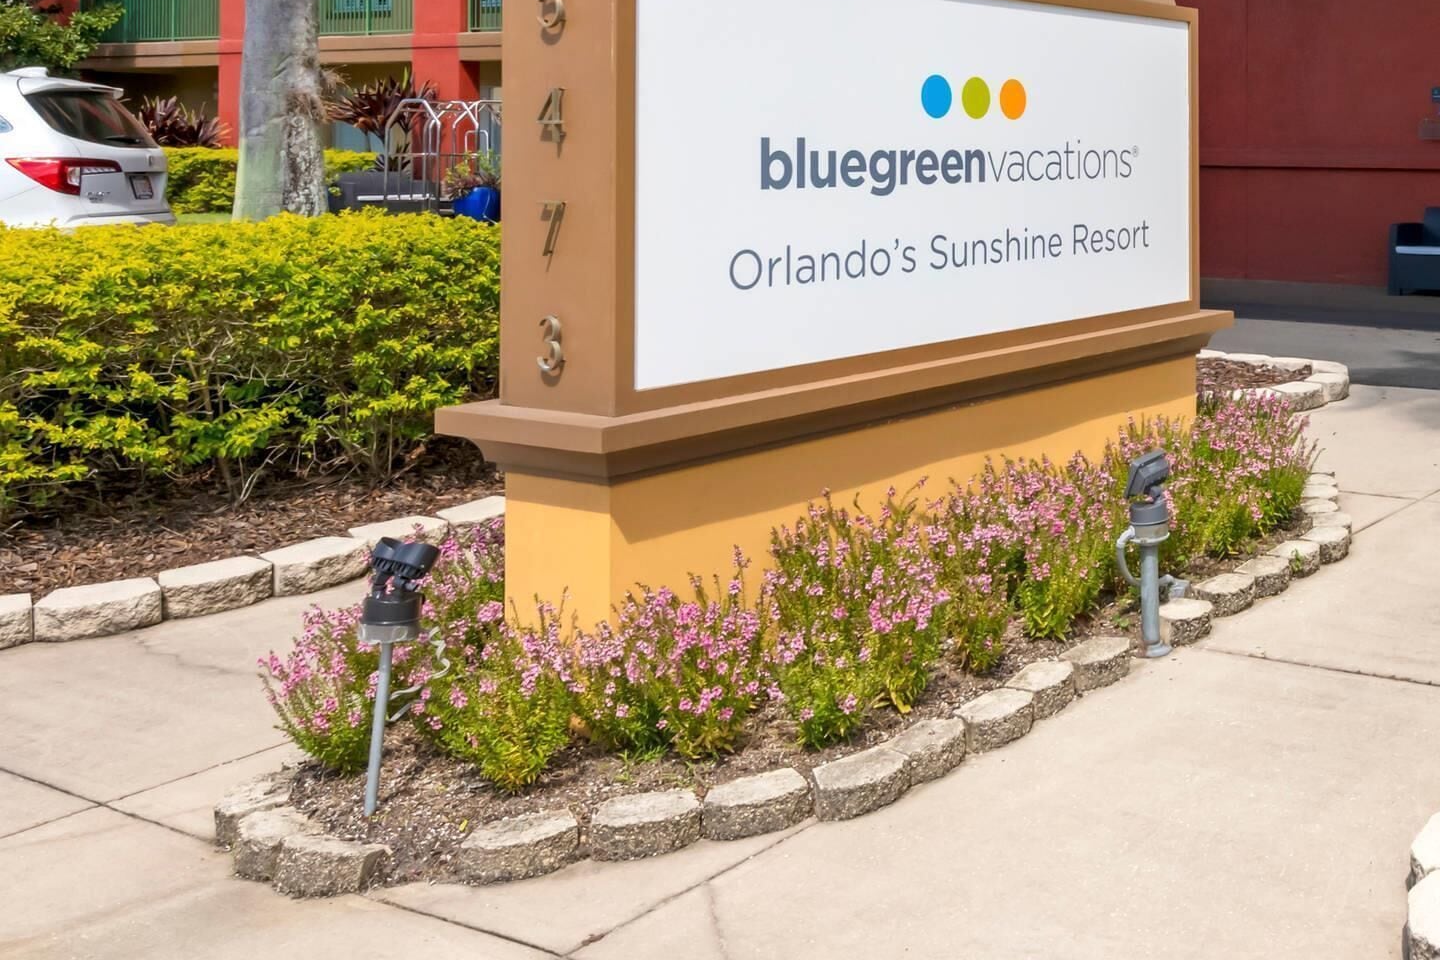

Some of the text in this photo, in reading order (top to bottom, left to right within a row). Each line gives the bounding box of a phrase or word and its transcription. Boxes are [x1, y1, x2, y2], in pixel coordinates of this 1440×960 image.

[729, 219, 1150, 290] Orlando’s Sunshine Resort
